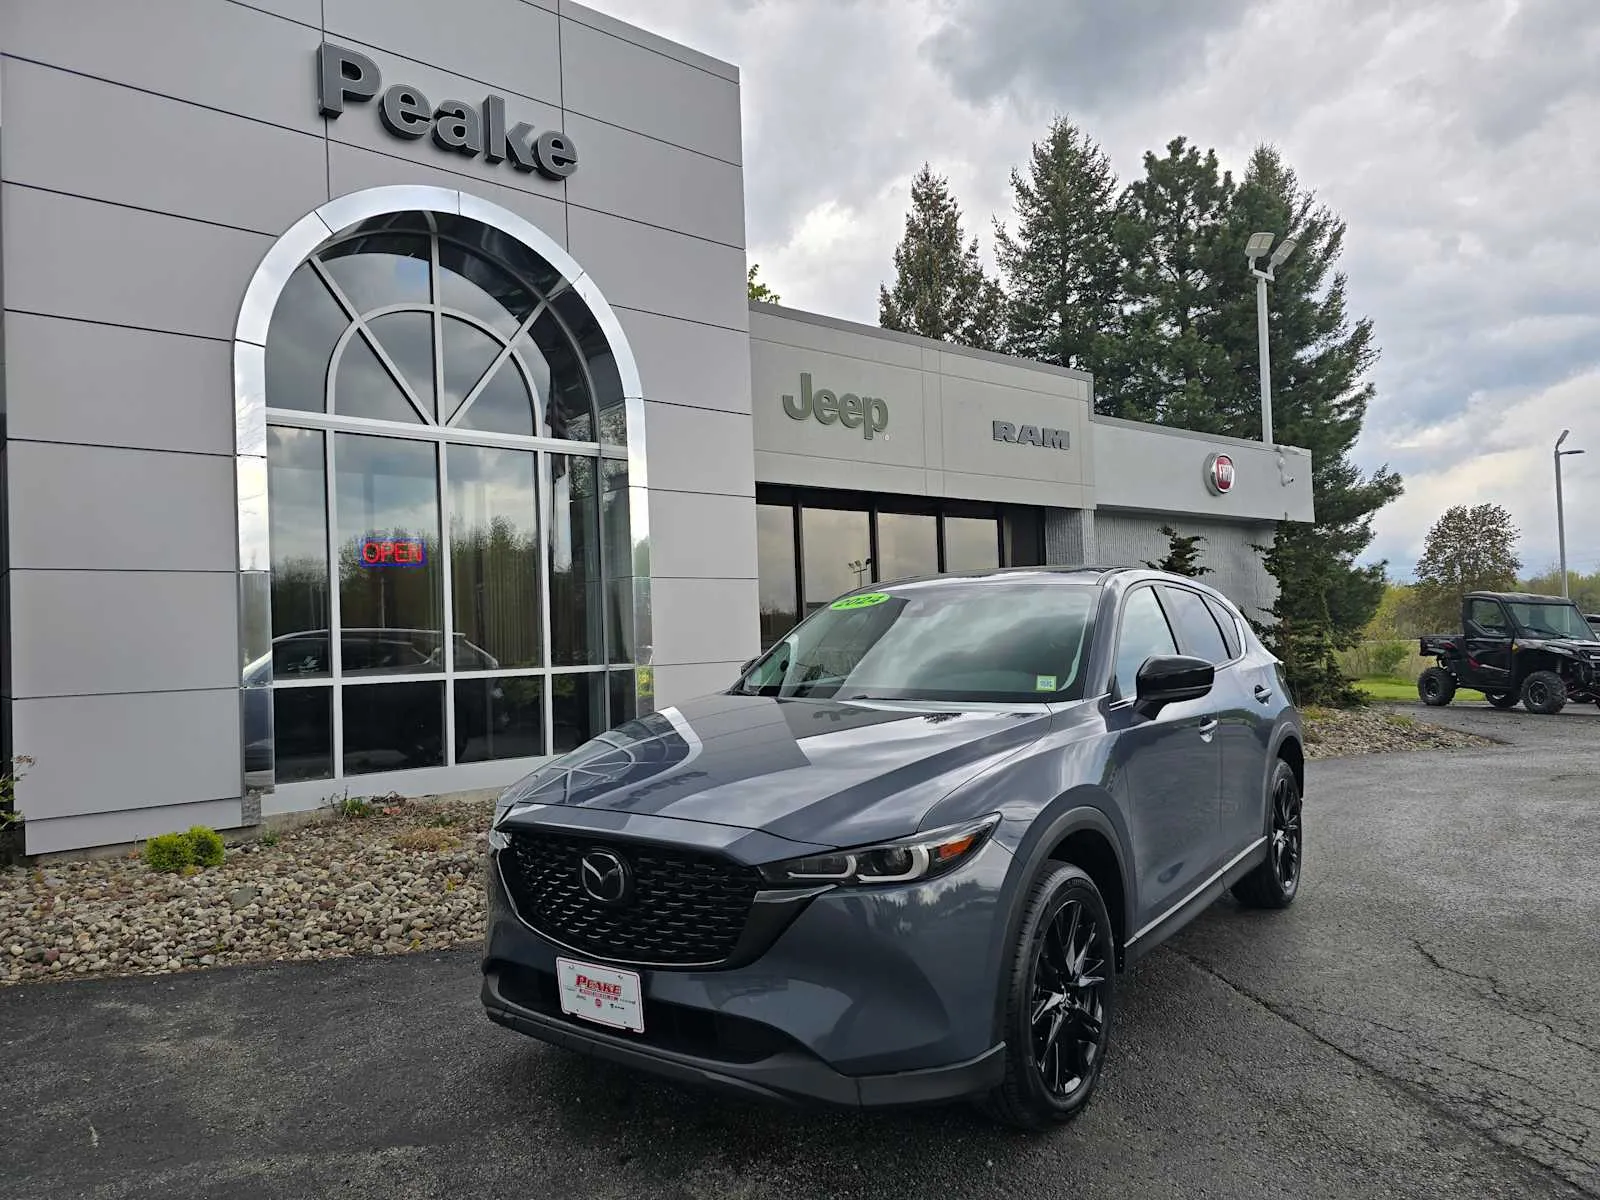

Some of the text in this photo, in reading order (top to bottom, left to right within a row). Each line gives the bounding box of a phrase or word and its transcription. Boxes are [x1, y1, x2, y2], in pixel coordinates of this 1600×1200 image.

[316, 41, 578, 181] Peake
[782, 372, 889, 440] Jeep
[992, 420, 1070, 450] RAM
[363, 542, 422, 563] OPEN
[576, 973, 621, 995] PEAKE
